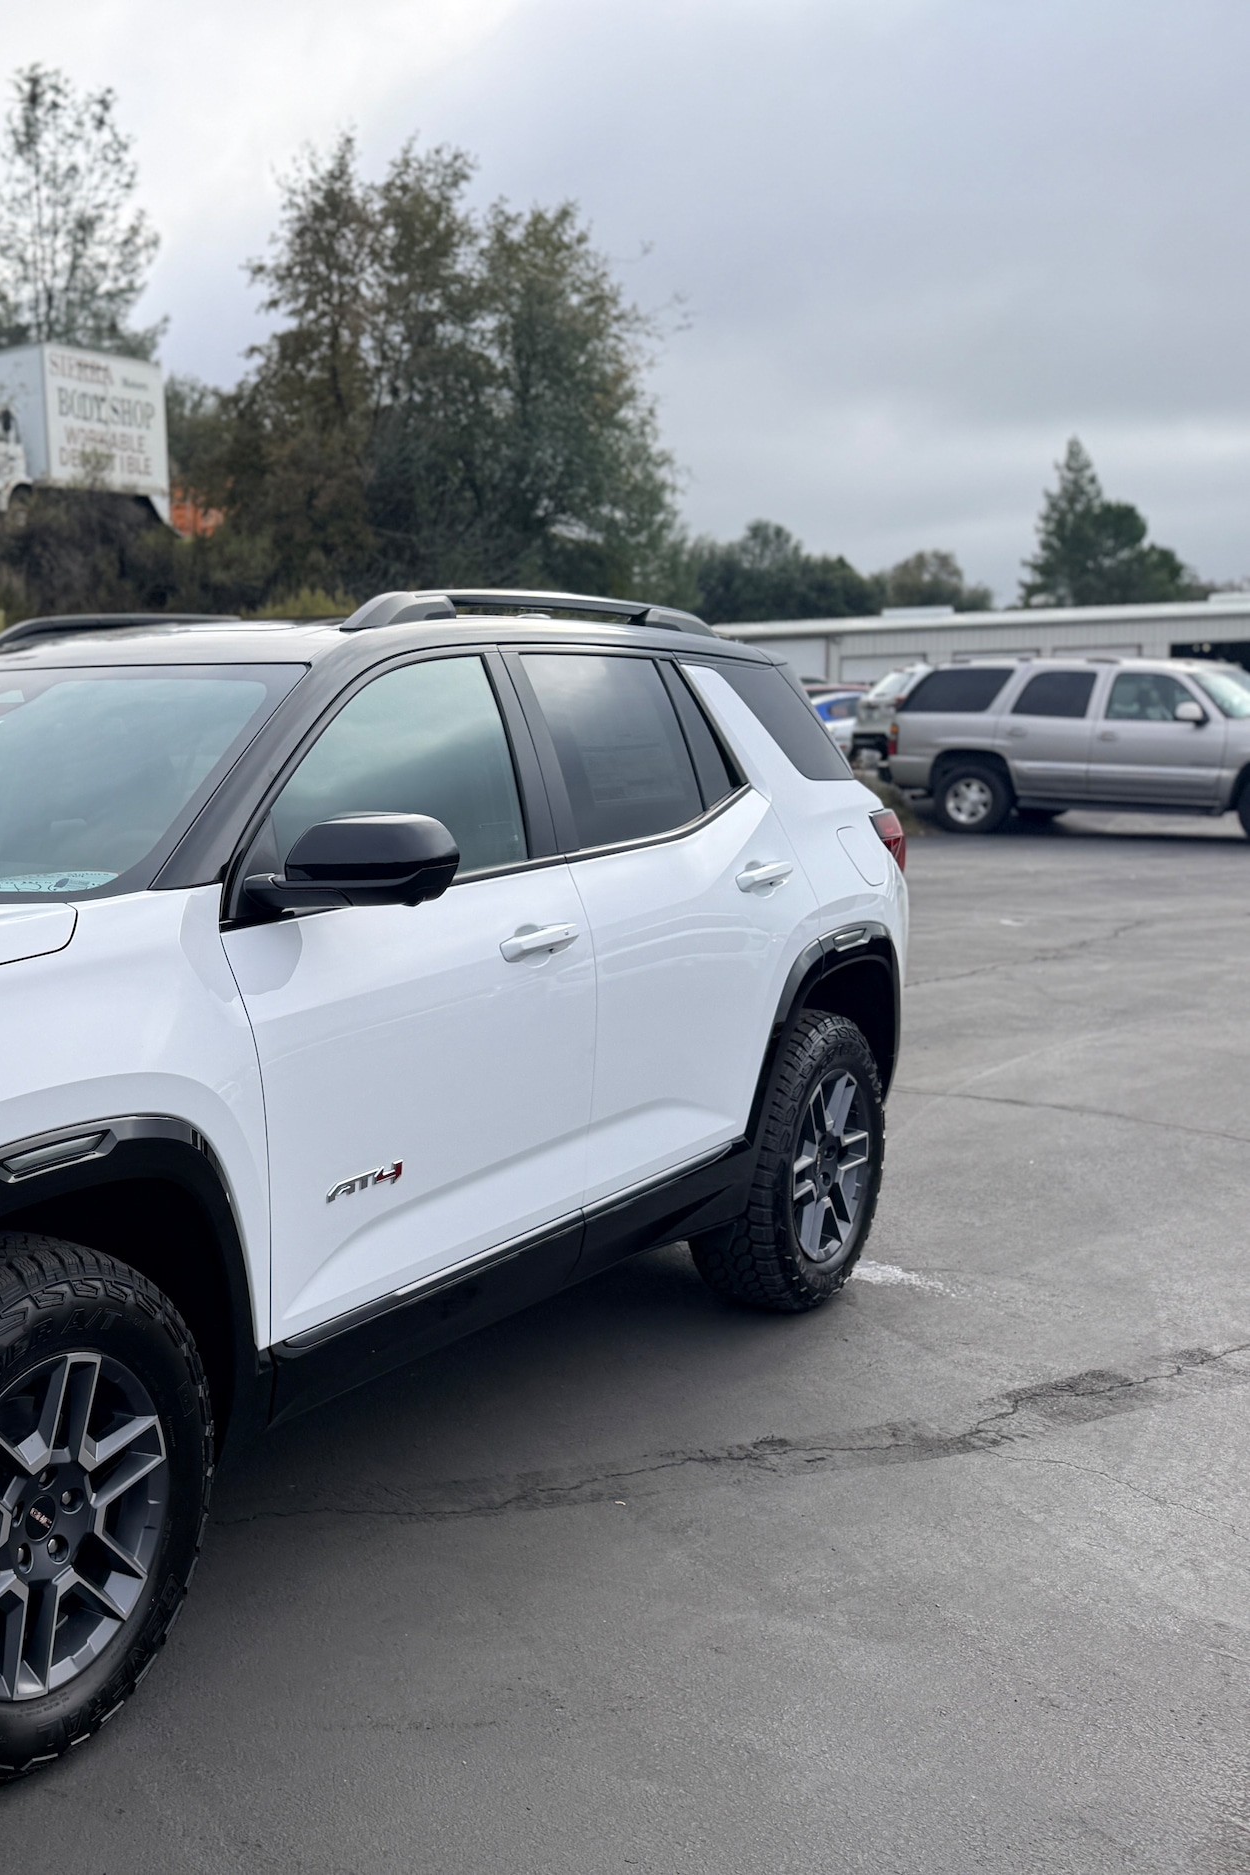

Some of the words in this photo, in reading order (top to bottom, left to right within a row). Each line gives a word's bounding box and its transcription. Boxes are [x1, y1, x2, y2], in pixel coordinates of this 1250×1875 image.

[57, 387, 107, 425] BODY
[109, 396, 155, 430] SHOP
[326, 1159, 403, 1204] AT4
